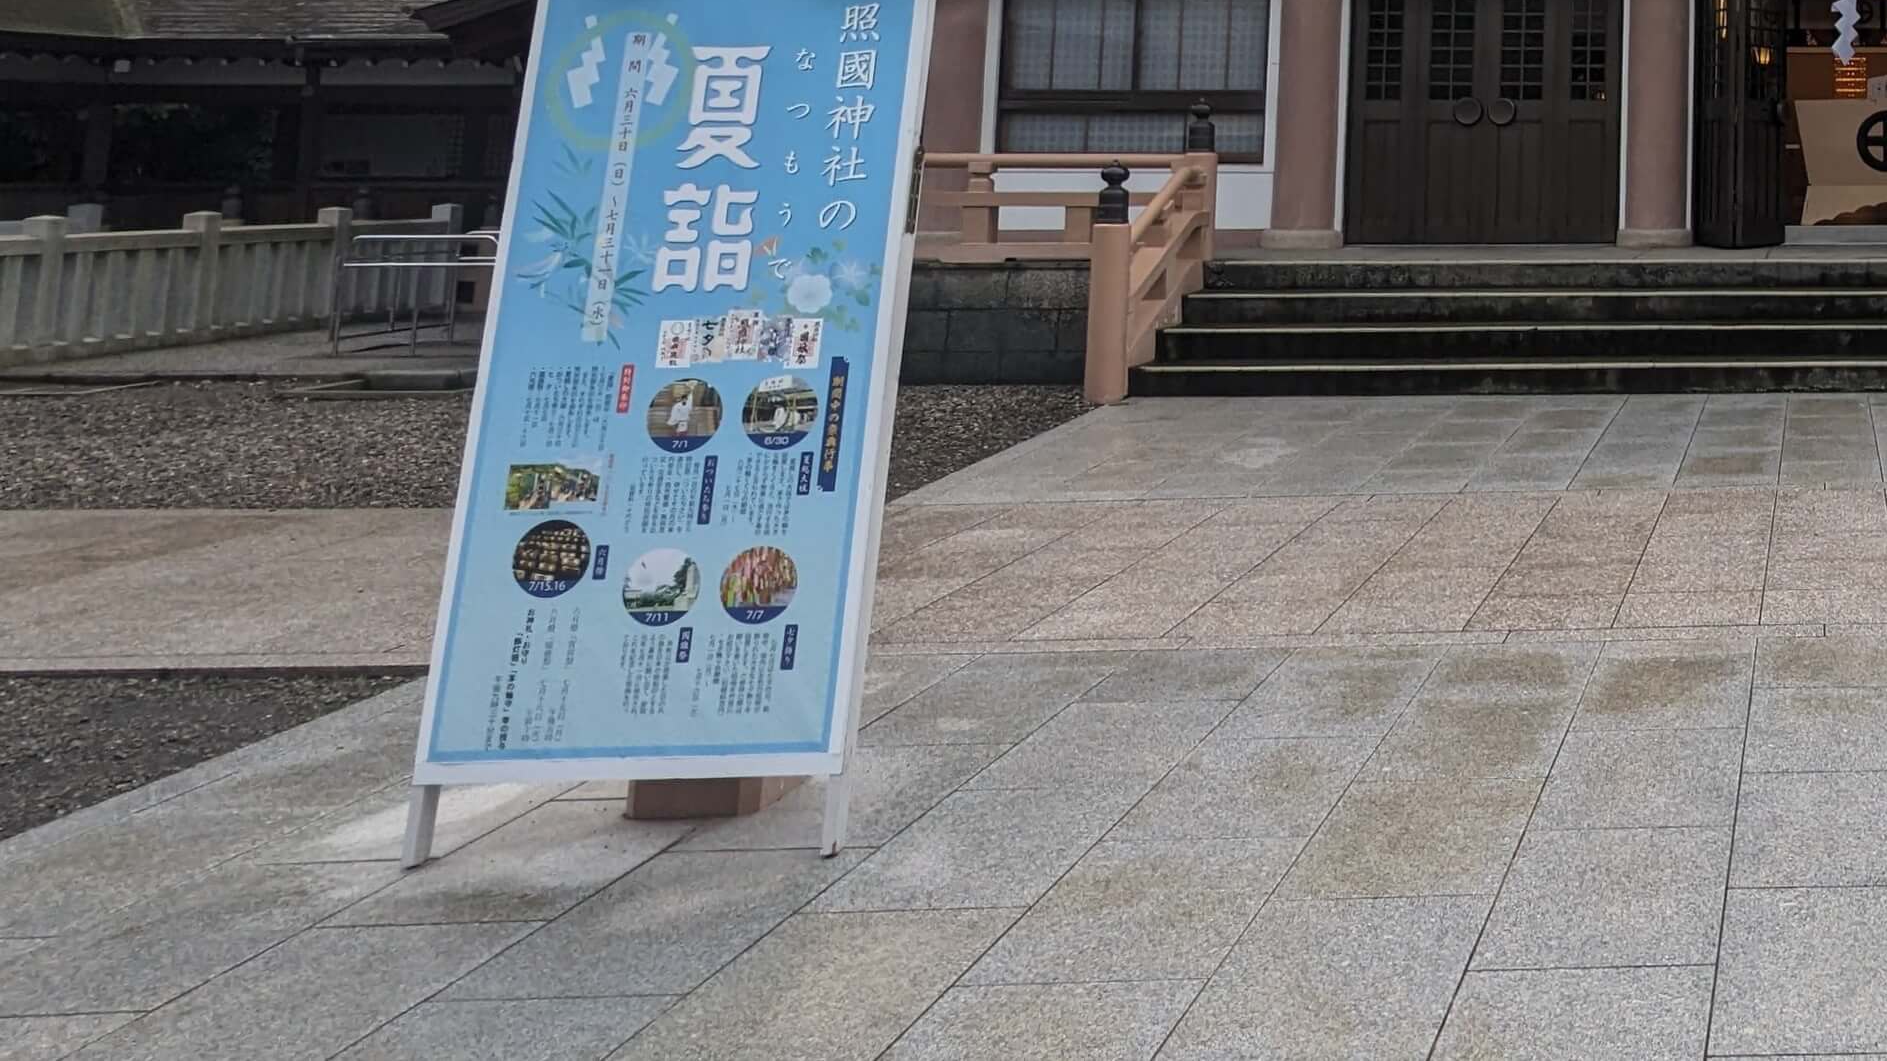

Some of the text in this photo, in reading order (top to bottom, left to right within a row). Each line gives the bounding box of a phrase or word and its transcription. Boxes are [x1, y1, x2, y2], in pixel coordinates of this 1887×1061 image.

[817, 3, 882, 231] 照國神社の
[768, 48, 817, 280] なつもうで
[652, 45, 772, 295] 夏詣
[672, 440, 688, 449] 7/1
[763, 436, 790, 446] 6/30
[645, 612, 669, 622] 7/11
[745, 609, 764, 620] 7/7
